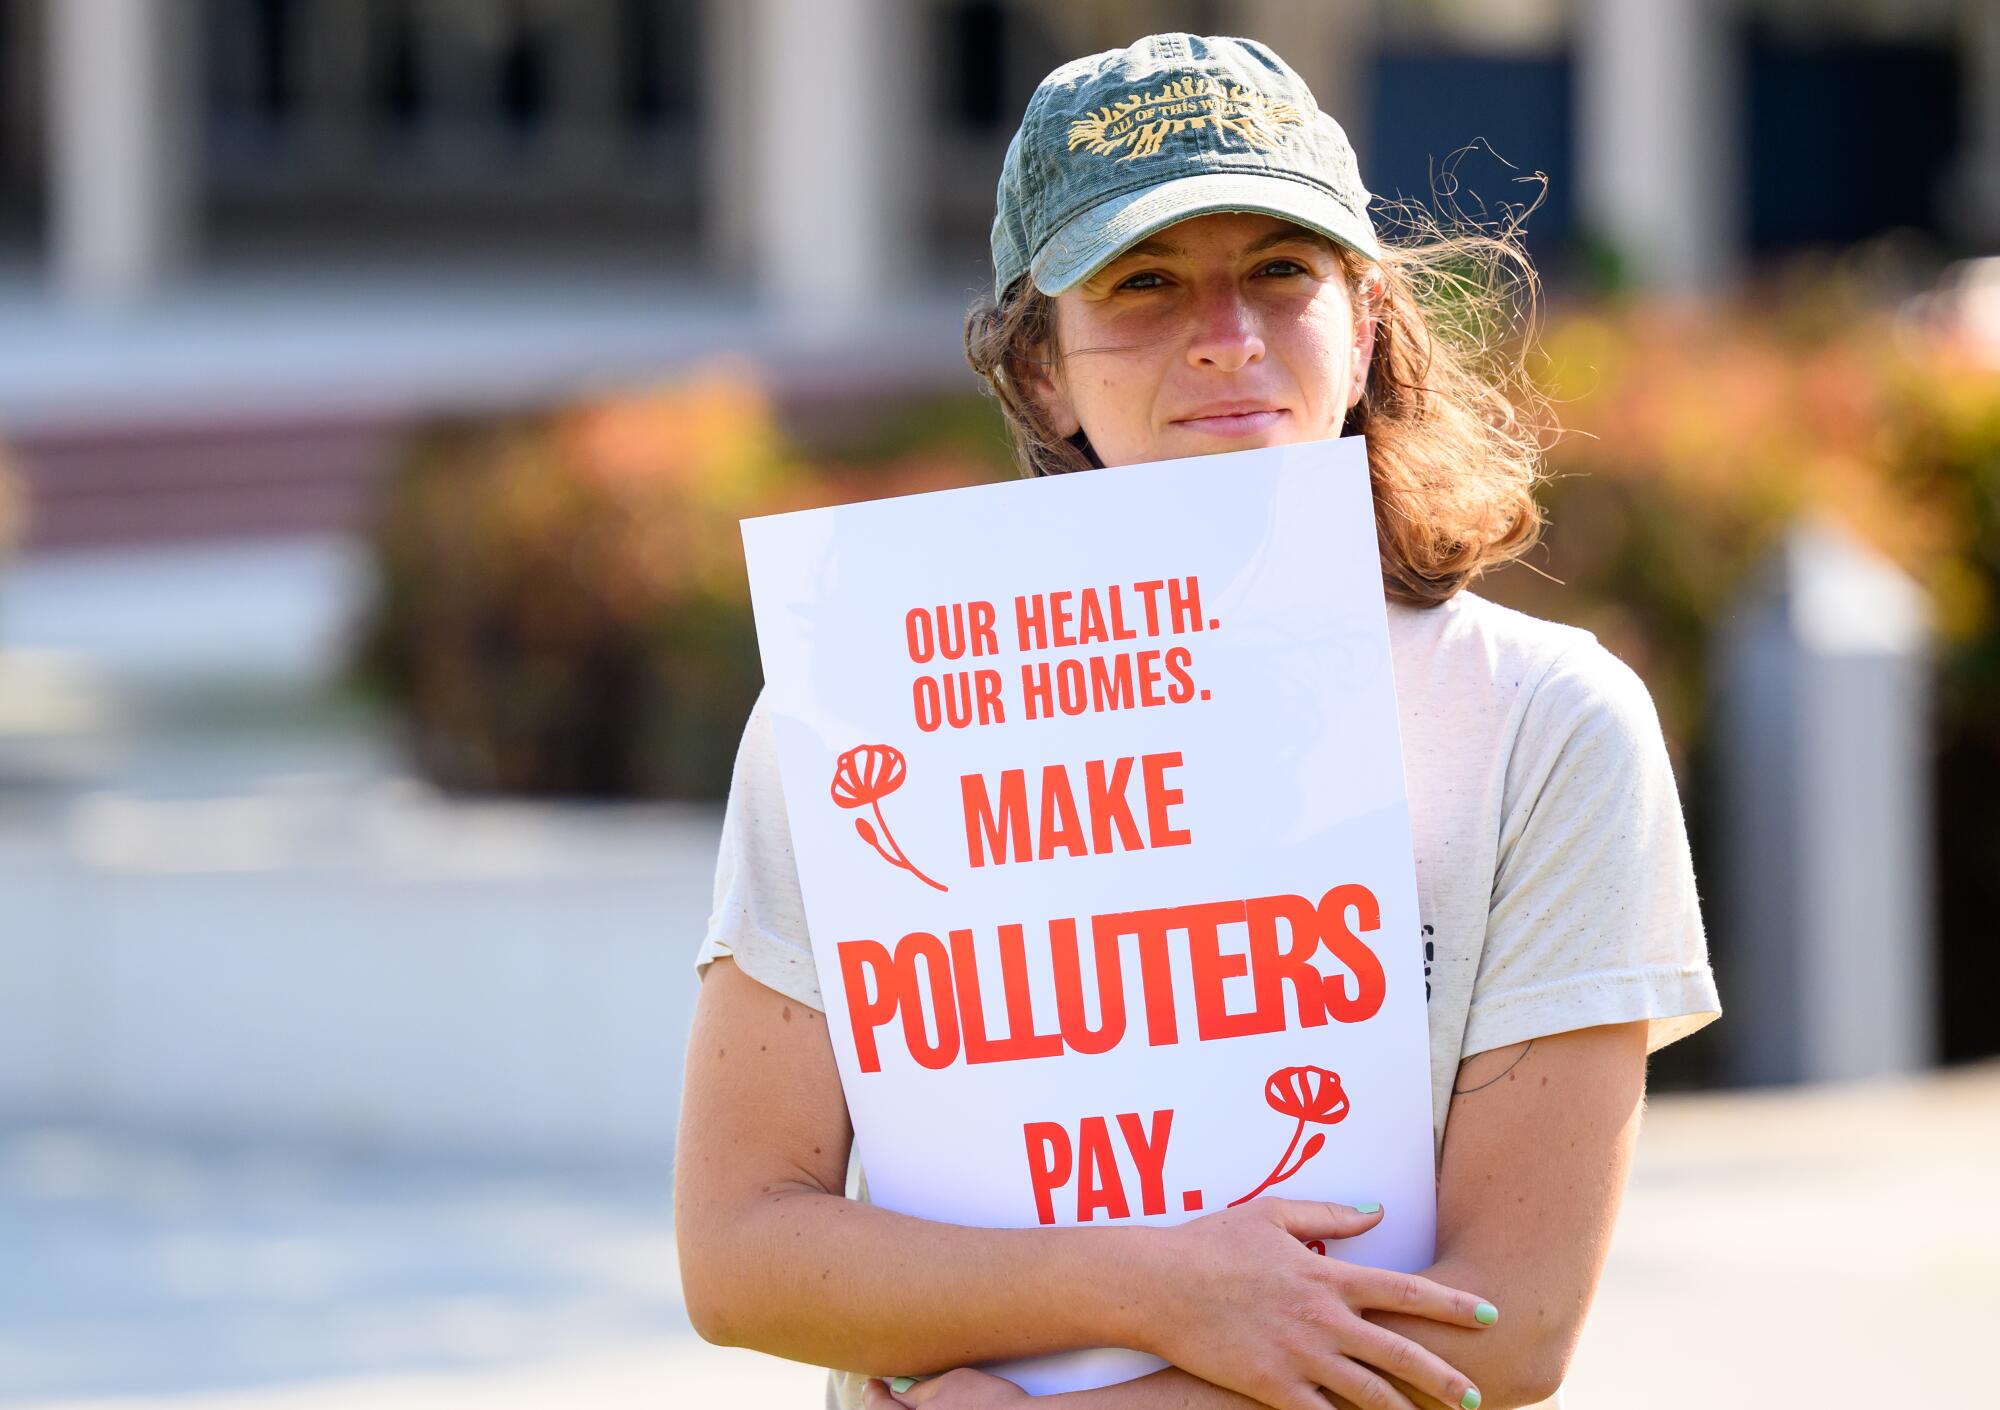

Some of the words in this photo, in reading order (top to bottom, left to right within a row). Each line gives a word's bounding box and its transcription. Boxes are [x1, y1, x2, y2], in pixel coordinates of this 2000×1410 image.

[1110, 116, 1134, 137] ALL
[1135, 107, 1155, 121] OF
[1158, 101, 1197, 116] THIS
[906, 602, 998, 664] OUR
[1016, 575, 1220, 651] HEALTH.
[913, 670, 1005, 729] OUR
[1022, 647, 1211, 720] HOMES.
[960, 752, 1191, 868] MAKE
[837, 883, 1386, 1073] POLLUTERS
[1024, 1109, 1203, 1225] PAY.
